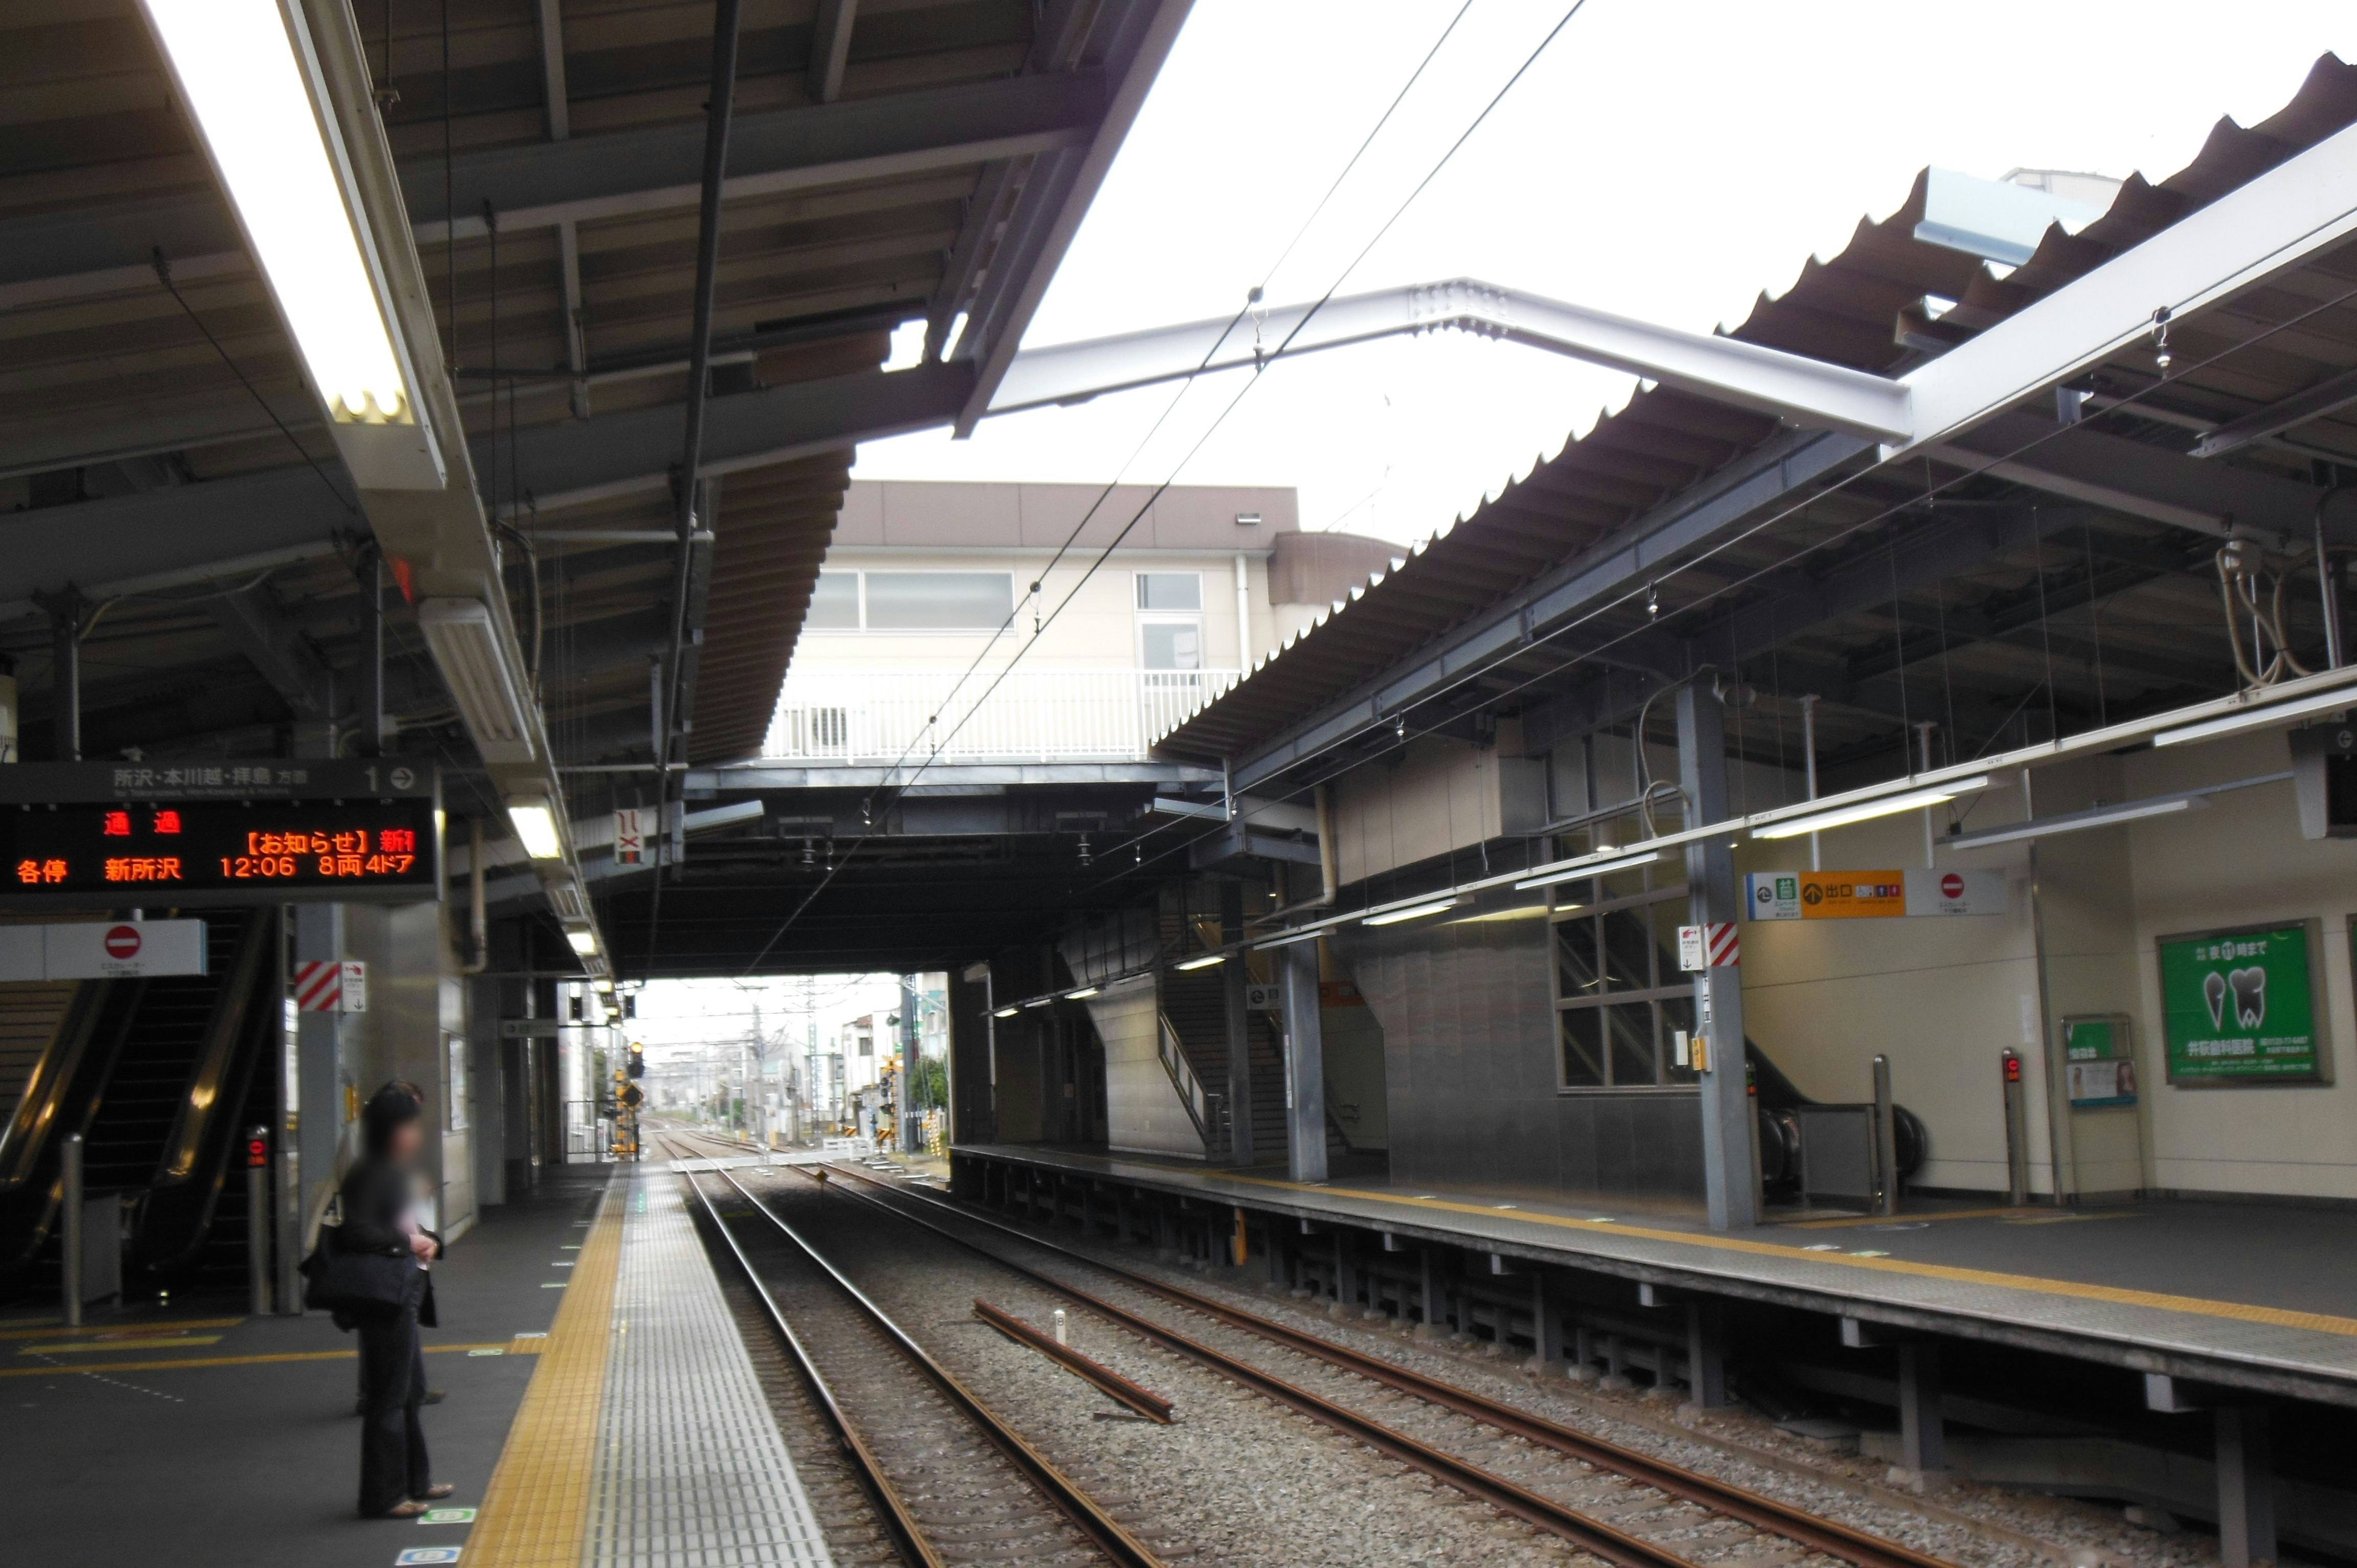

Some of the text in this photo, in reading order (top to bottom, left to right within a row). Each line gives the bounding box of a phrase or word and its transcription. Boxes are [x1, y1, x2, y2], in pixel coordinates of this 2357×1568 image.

[365, 767, 376, 791] 1
[18, 860, 68, 883] 各停
[105, 857, 182, 881] 新所沢
[220, 855, 296, 878] 12:06
[1826, 884, 1852, 898] 出口
